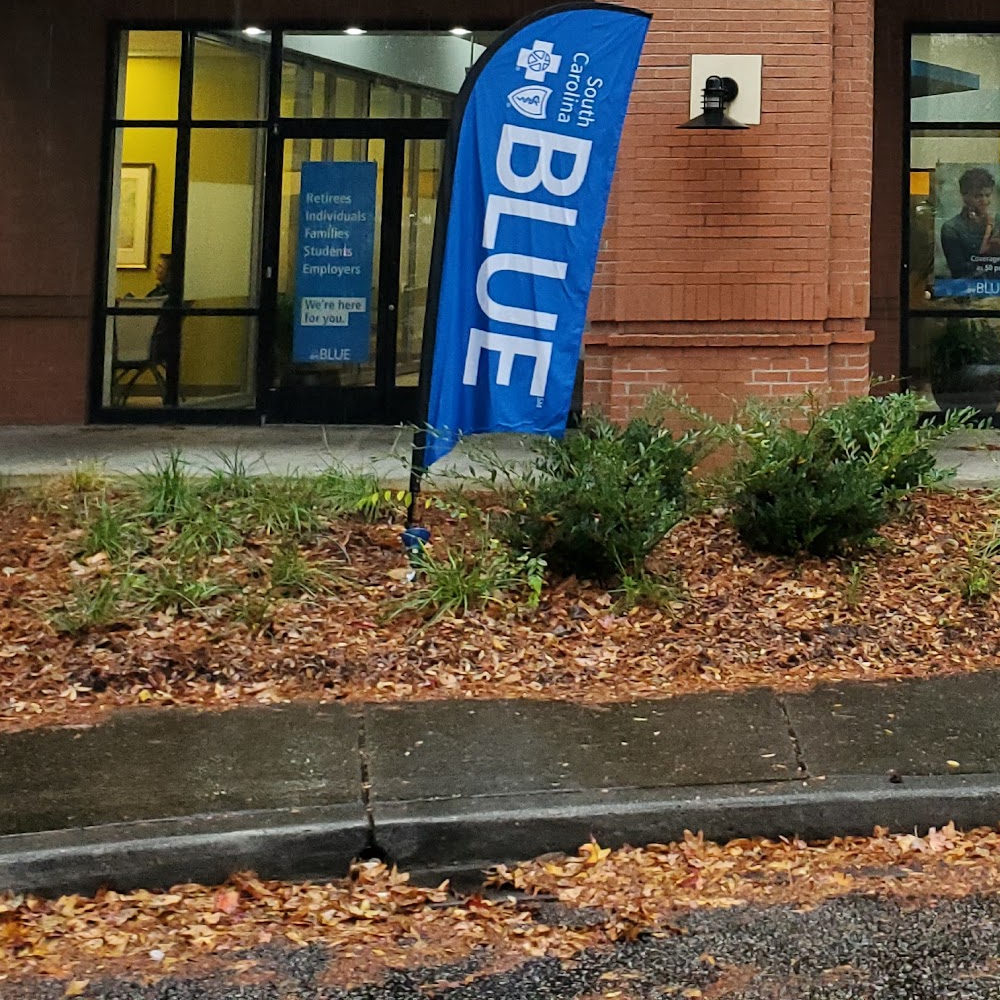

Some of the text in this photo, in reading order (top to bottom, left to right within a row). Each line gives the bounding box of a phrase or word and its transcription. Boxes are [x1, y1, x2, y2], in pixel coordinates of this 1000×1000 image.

[557, 52, 590, 123] Carolina
[576, 75, 604, 128] South
[306, 192, 352, 204] Retirees
[305, 210, 367, 222] Individuals
[304, 227, 350, 239] Families
[303, 245, 353, 258] Students
[462, 123, 593, 397] BLUE
[970, 255, 1000, 264] Coverage
[302, 263, 361, 277] Employers
[304, 299, 362, 310] We're here
[304, 312, 345, 326] for you.
[319, 348, 351, 360] BLUE
